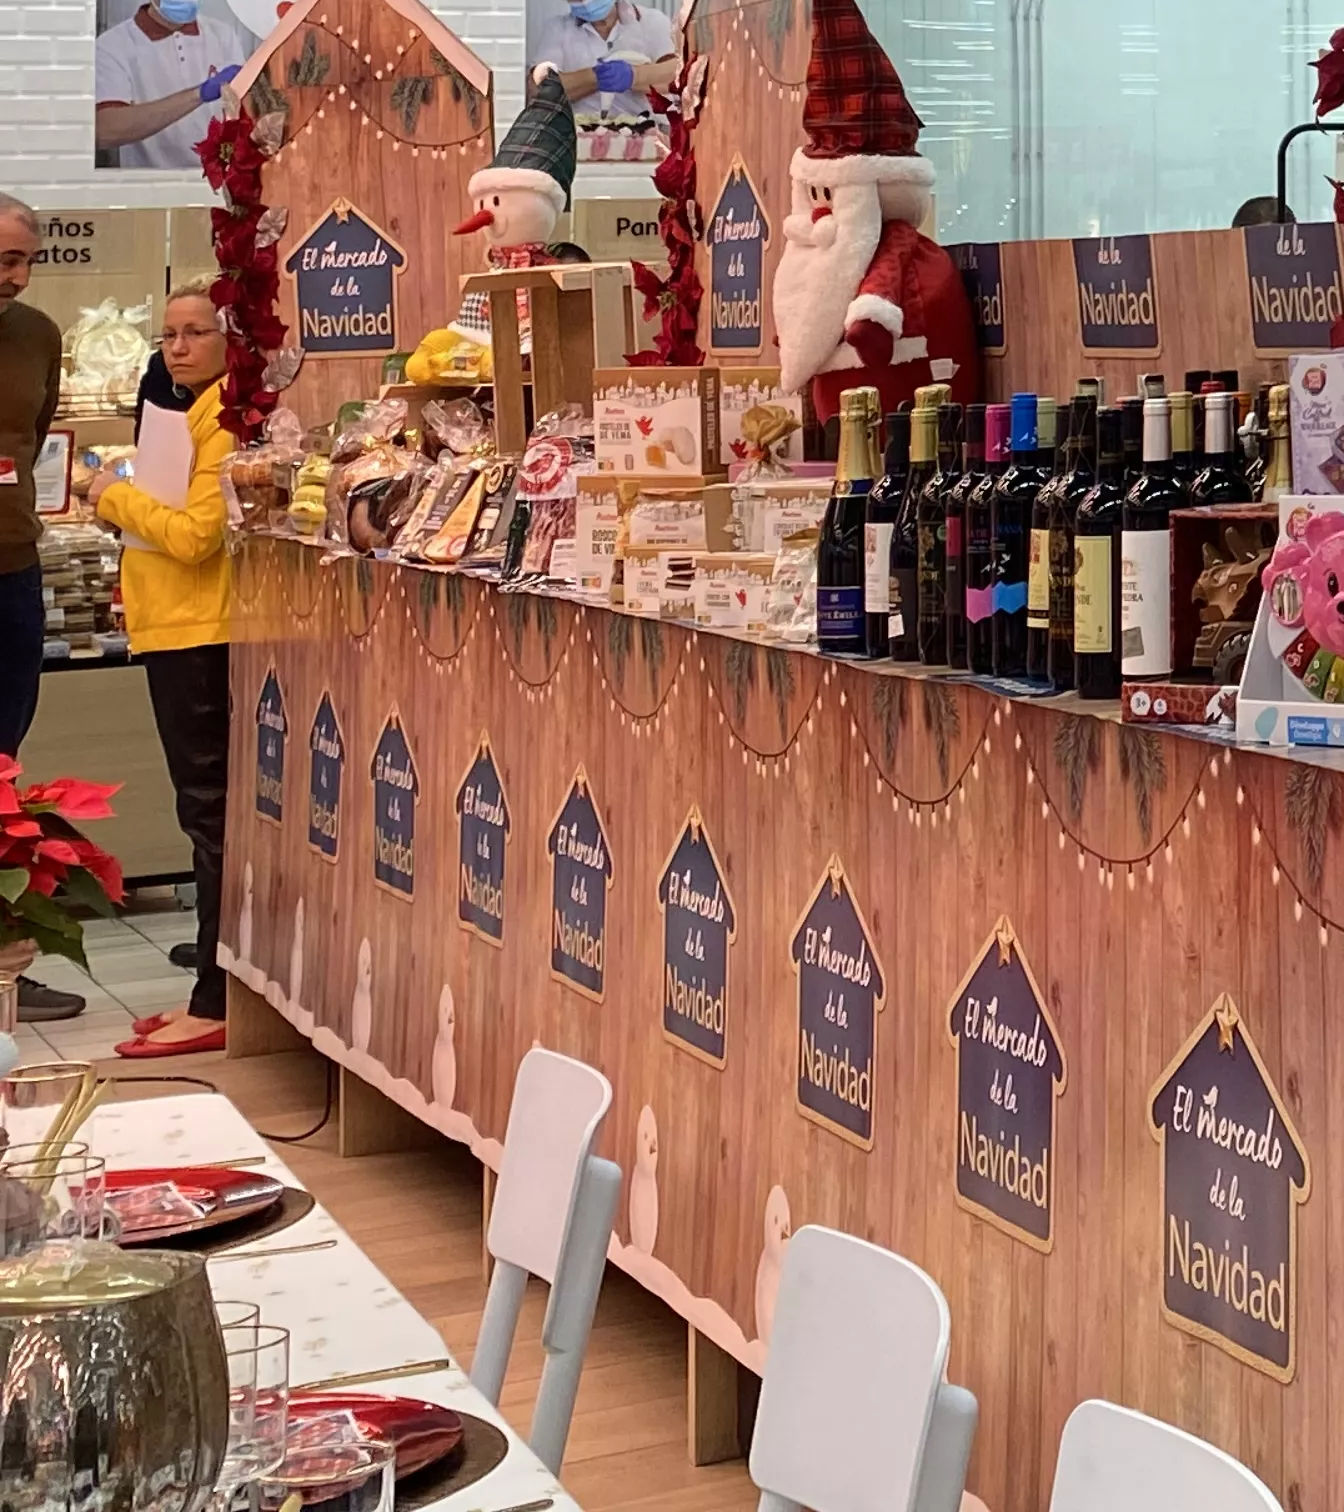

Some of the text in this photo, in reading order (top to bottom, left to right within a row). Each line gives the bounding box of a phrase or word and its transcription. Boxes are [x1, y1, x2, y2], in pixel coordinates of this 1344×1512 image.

[302, 238, 388, 270] El mercado
[330, 275, 360, 296] de la
[713, 289, 760, 329] Navidad
[1081, 278, 1155, 326] Navidad
[1252, 272, 1344, 325] Navidad
[303, 303, 392, 338] Navidad
[376, 825, 413, 876] Navidad
[557, 824, 605, 870] El mercado
[461, 863, 503, 919] Navidad
[668, 871, 725, 922] El mercado
[555, 909, 603, 971] Navidad
[804, 927, 871, 987] El mercado
[666, 963, 724, 1035] Navidad
[964, 997, 1048, 1067] El mercado
[801, 1028, 871, 1112] Navidad
[990, 1069, 1019, 1114] de la
[1173, 1085, 1282, 1169] El mercado
[960, 1110, 1048, 1209] Navidad
[1209, 1168, 1246, 1221] de la
[1169, 1213, 1286, 1332] Navidad
